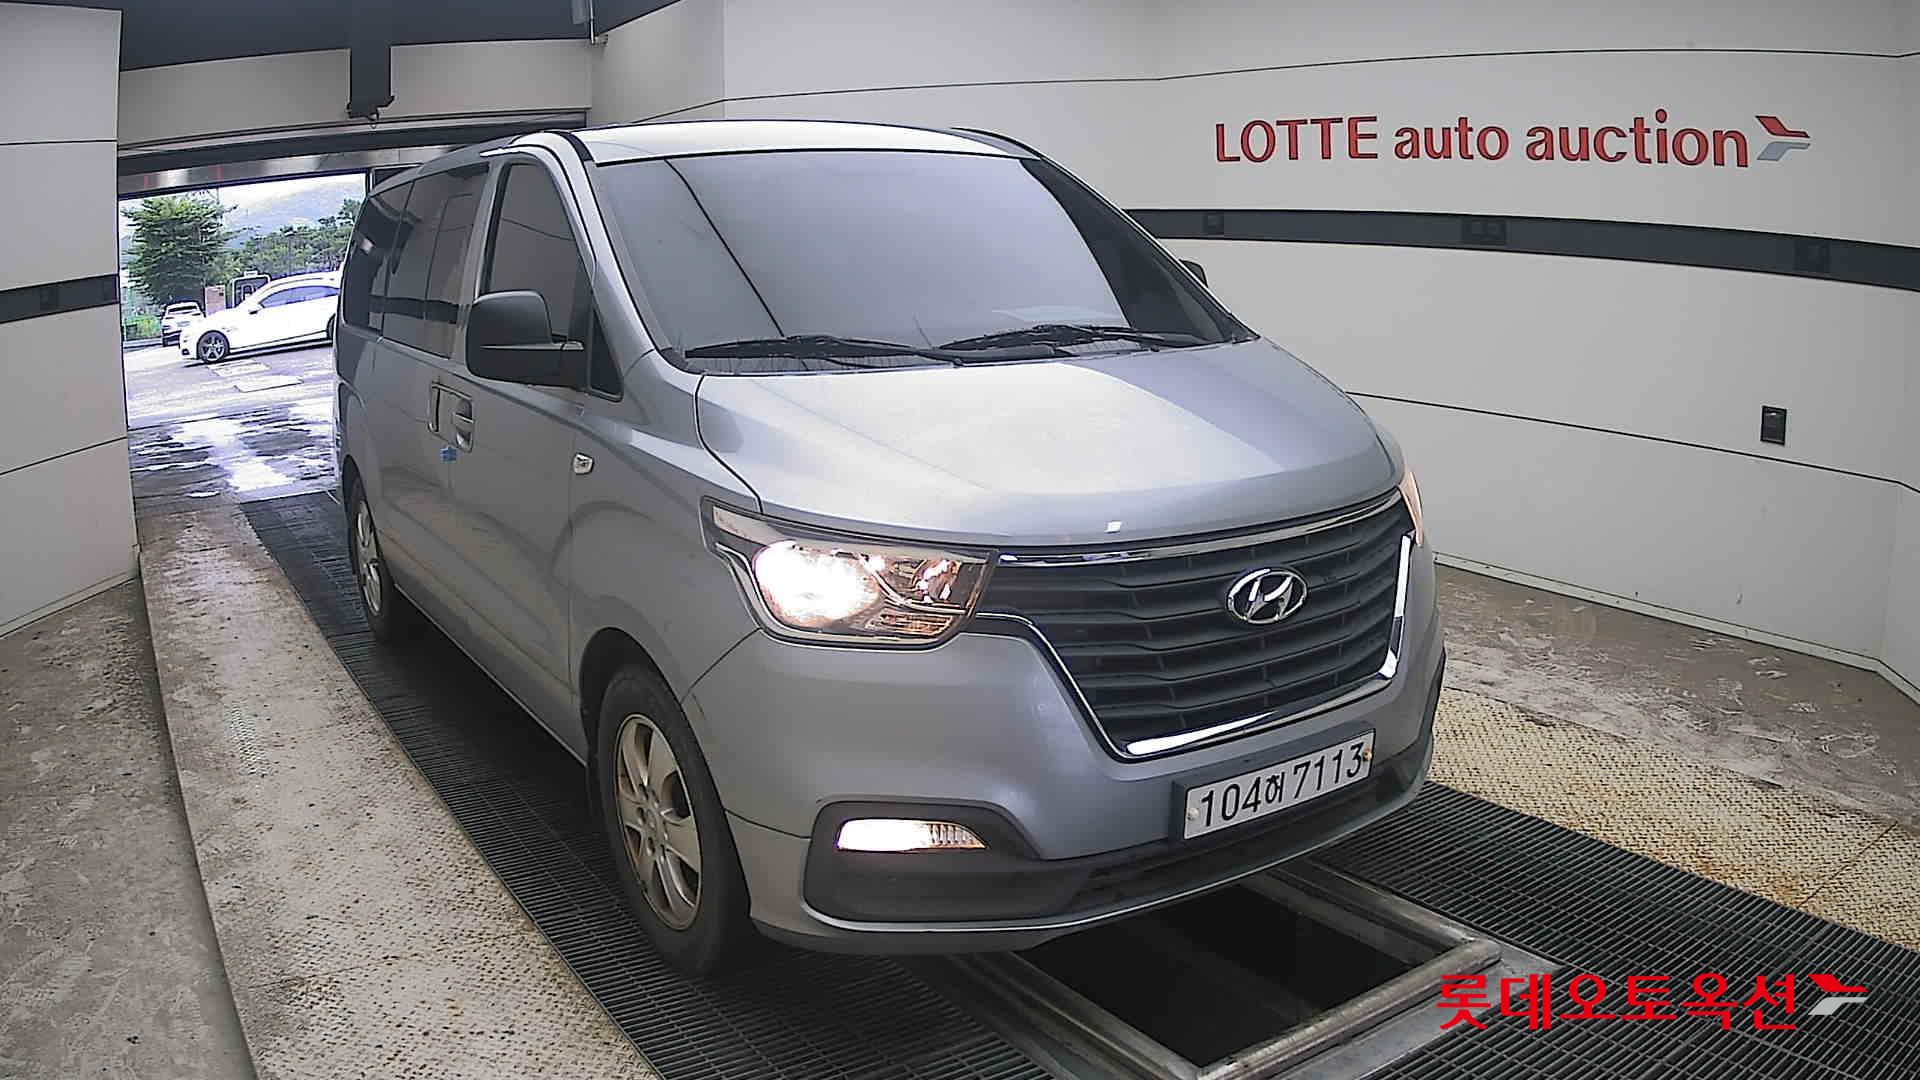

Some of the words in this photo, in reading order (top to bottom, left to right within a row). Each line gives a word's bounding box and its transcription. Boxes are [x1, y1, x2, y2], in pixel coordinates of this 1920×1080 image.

[1215, 115, 1379, 162] LOTTE
[1393, 116, 1510, 161] auto
[1524, 108, 1749, 168] auction
[1201, 771, 1286, 827] 104허
[1292, 741, 1366, 799] 7113
